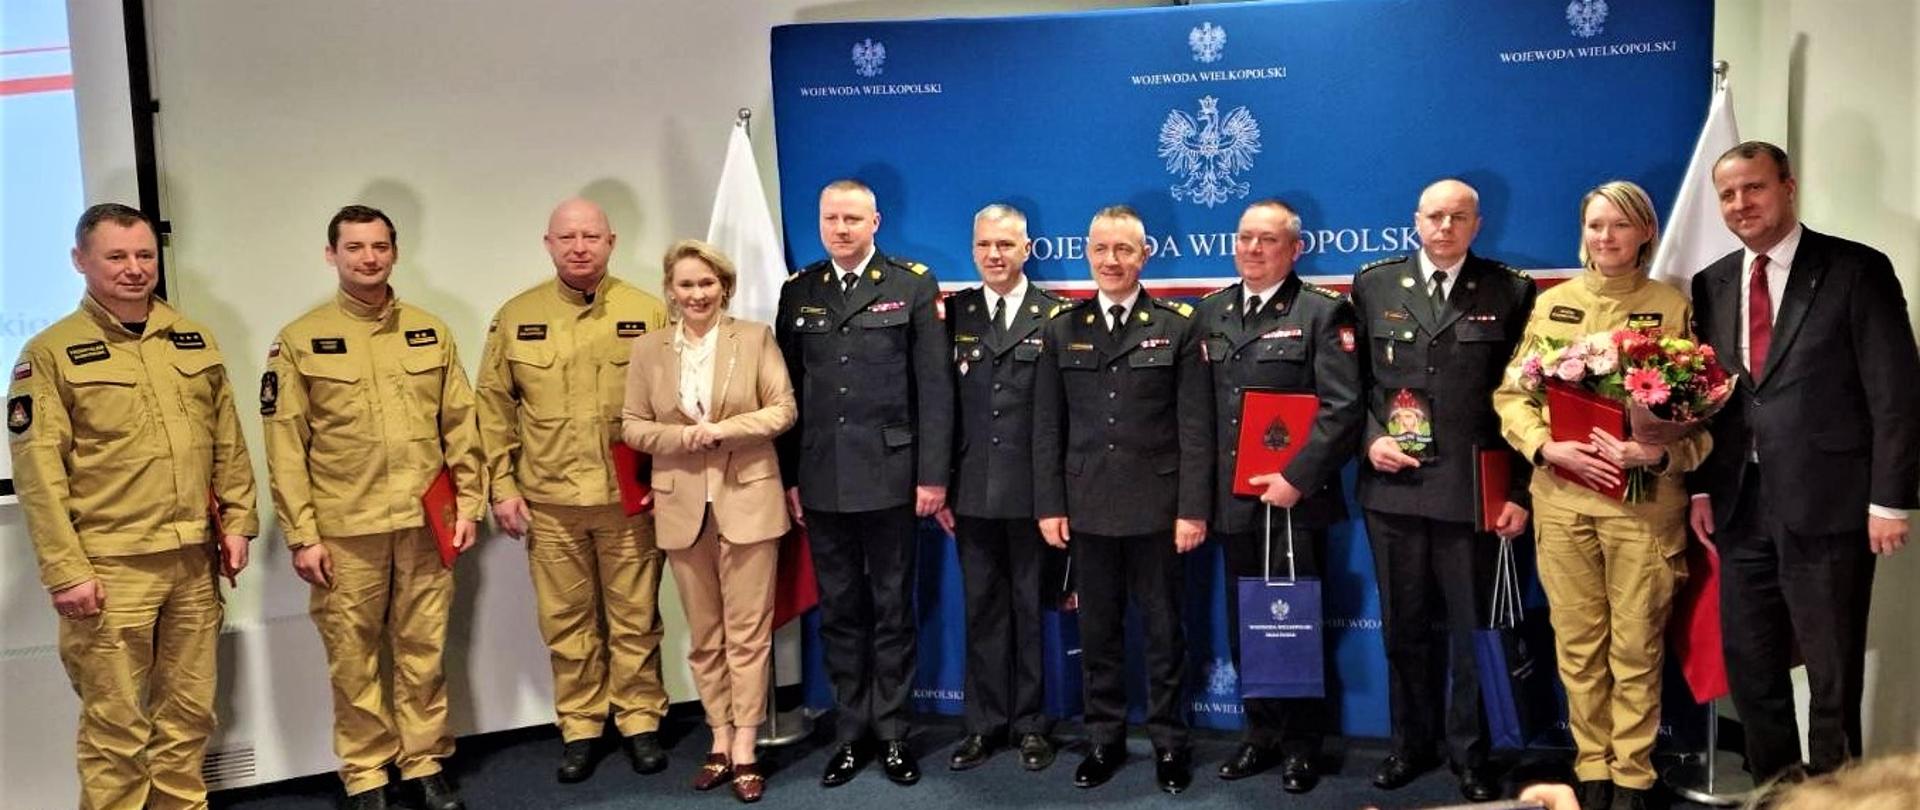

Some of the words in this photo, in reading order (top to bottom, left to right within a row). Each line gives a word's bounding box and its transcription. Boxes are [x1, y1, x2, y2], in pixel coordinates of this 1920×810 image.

[1500, 48, 1575, 62] WOJEWODA
[1577, 40, 1676, 57] WIELKOPOLSKI
[1131, 73, 1198, 85] WOJEWODA
[1199, 67, 1287, 82] WIELKOPOLSKI
[800, 86, 860, 97] WOJEWODA
[862, 83, 942, 95] WIELKOPOLSKI
